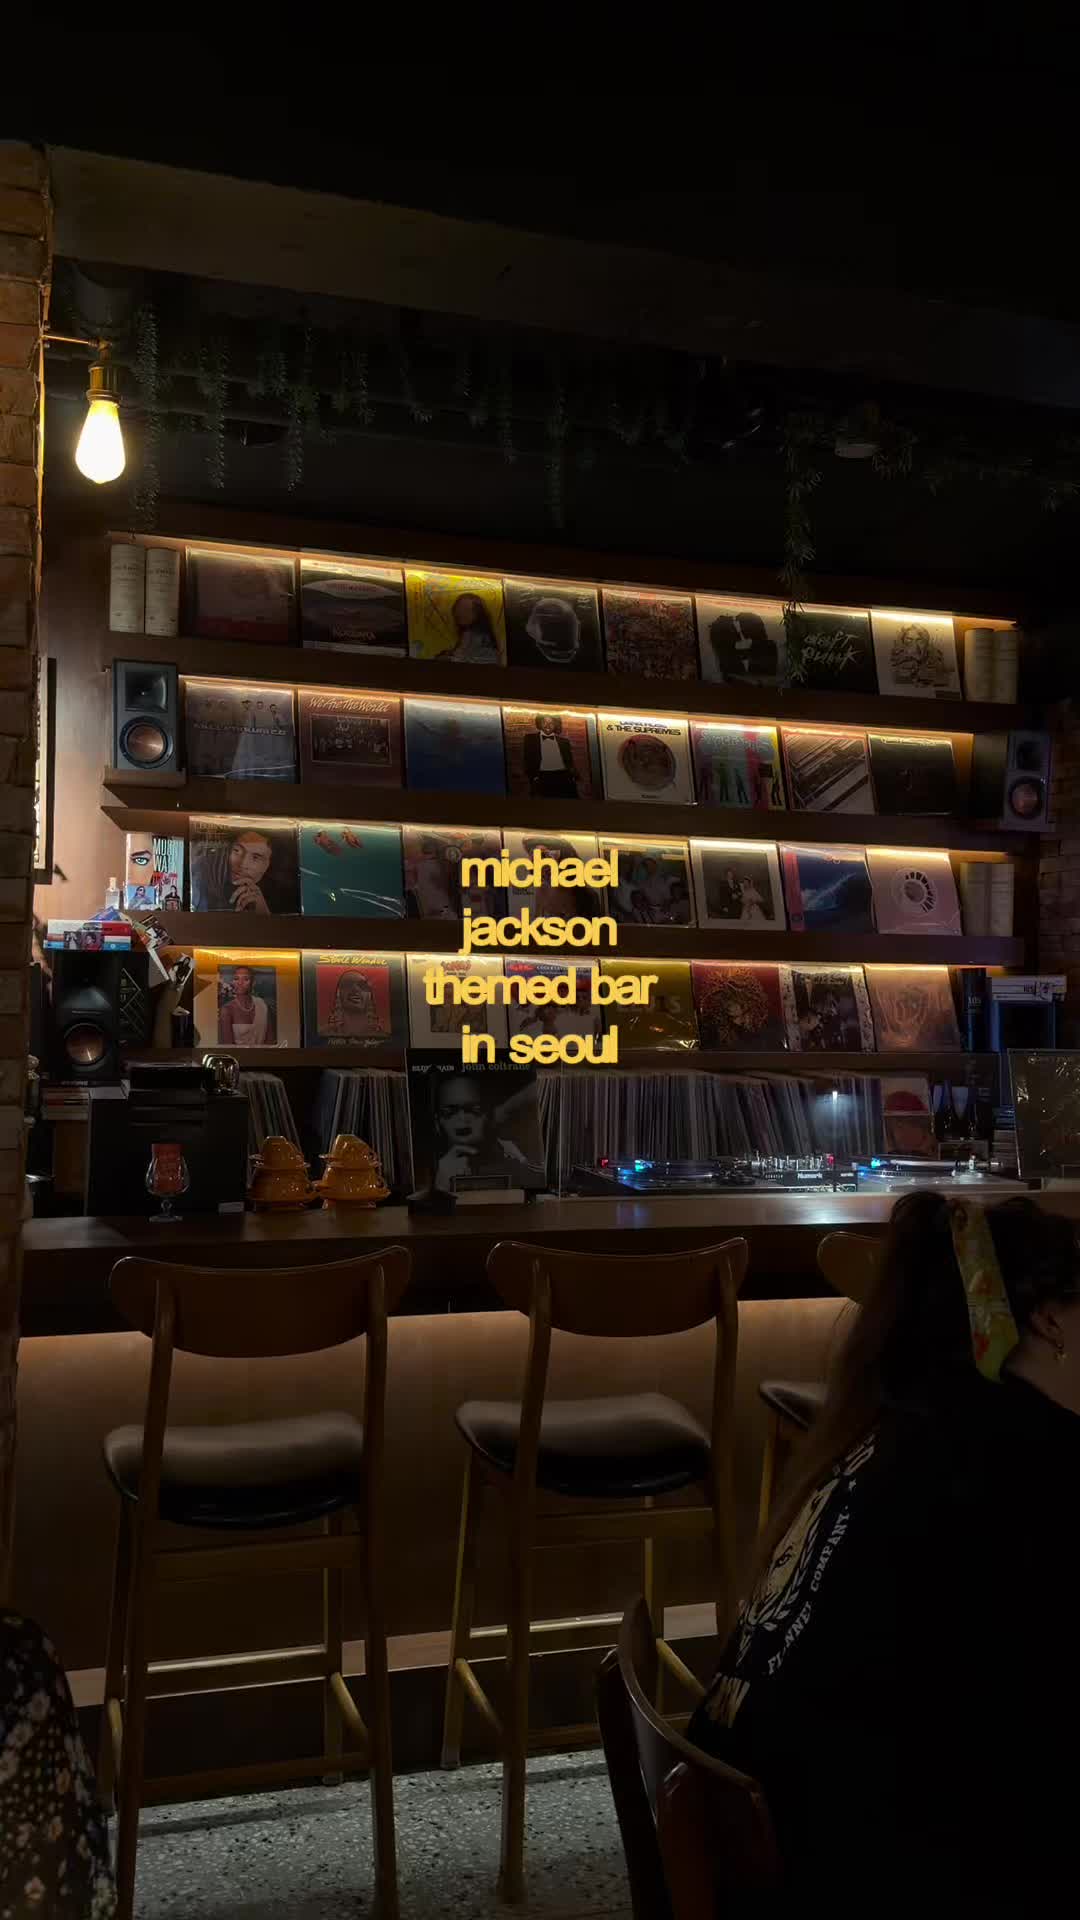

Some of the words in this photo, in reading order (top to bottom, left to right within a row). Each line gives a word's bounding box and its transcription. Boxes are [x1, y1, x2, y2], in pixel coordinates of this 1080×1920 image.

[615, 725, 633, 733] THE
[633, 726, 682, 736] SUPREMES
[810, 1512, 850, 1592] COMPANY
